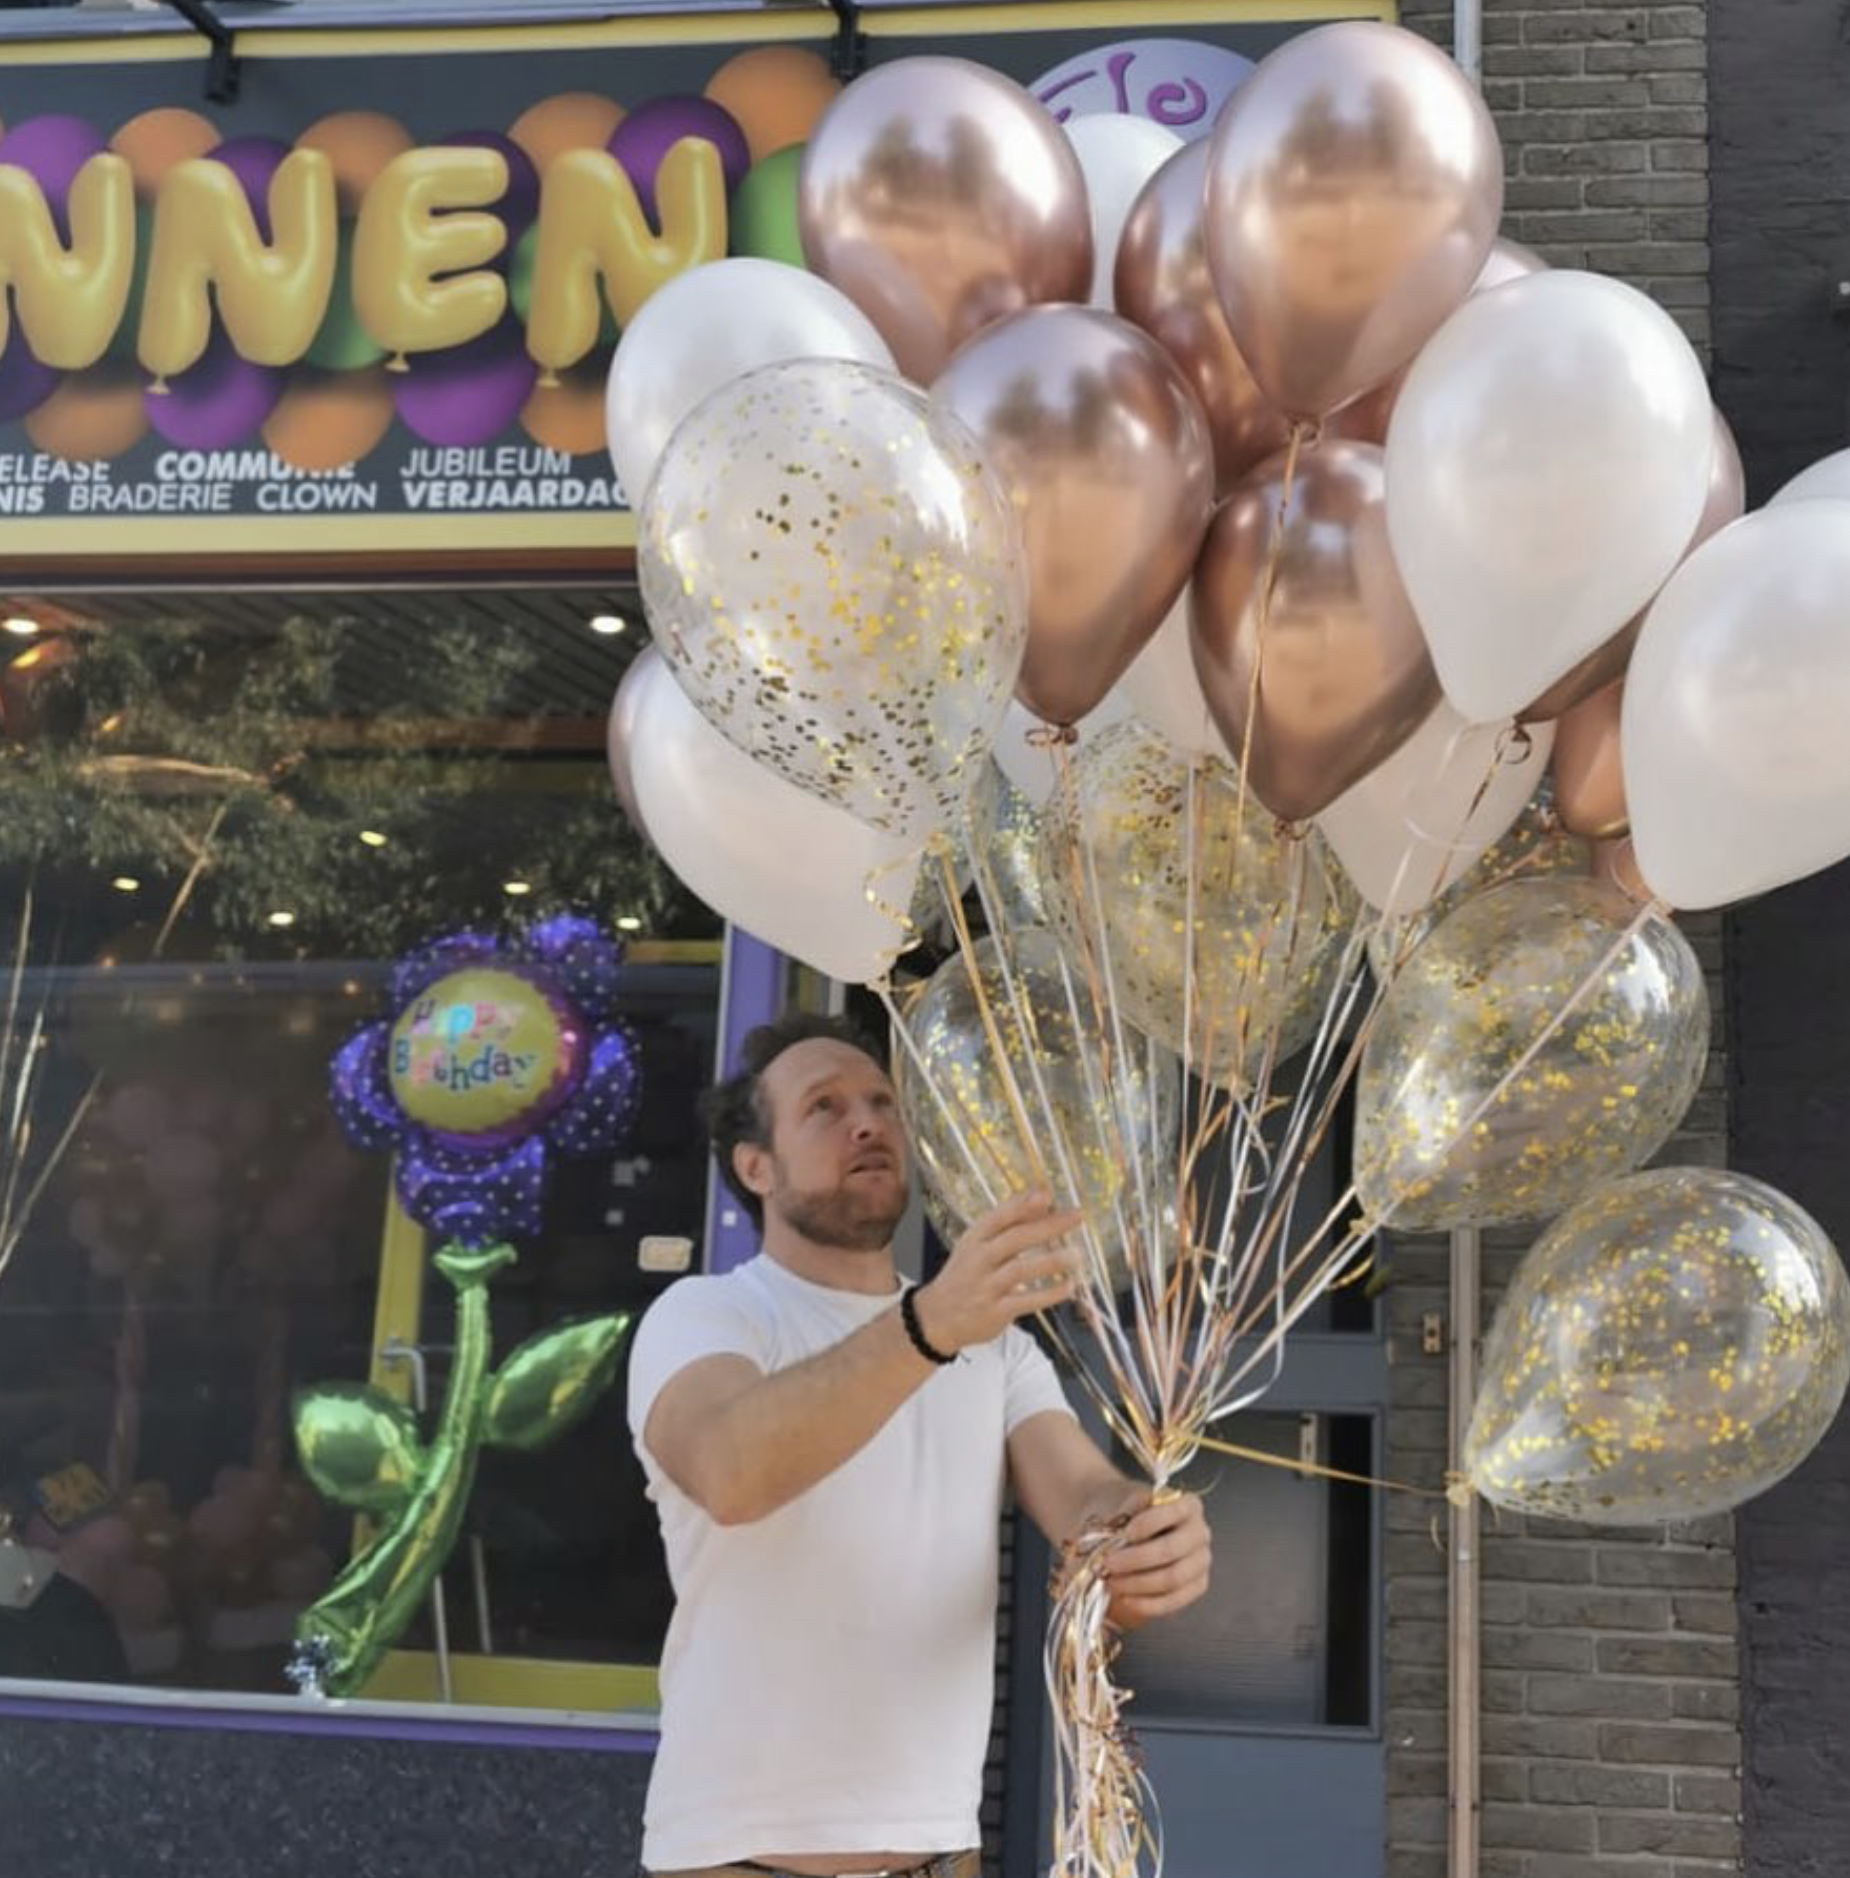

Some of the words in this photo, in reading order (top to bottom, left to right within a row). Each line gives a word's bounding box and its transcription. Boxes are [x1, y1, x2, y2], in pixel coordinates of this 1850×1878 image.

[0, 136, 728, 395] NNEN
[0, 454, 110, 483] ELEASE
[155, 450, 356, 480] COMMUE
[400, 446, 571, 477] JUBILEUM
[68, 482, 233, 511] BRADERIE
[256, 481, 378, 511] CLOWN
